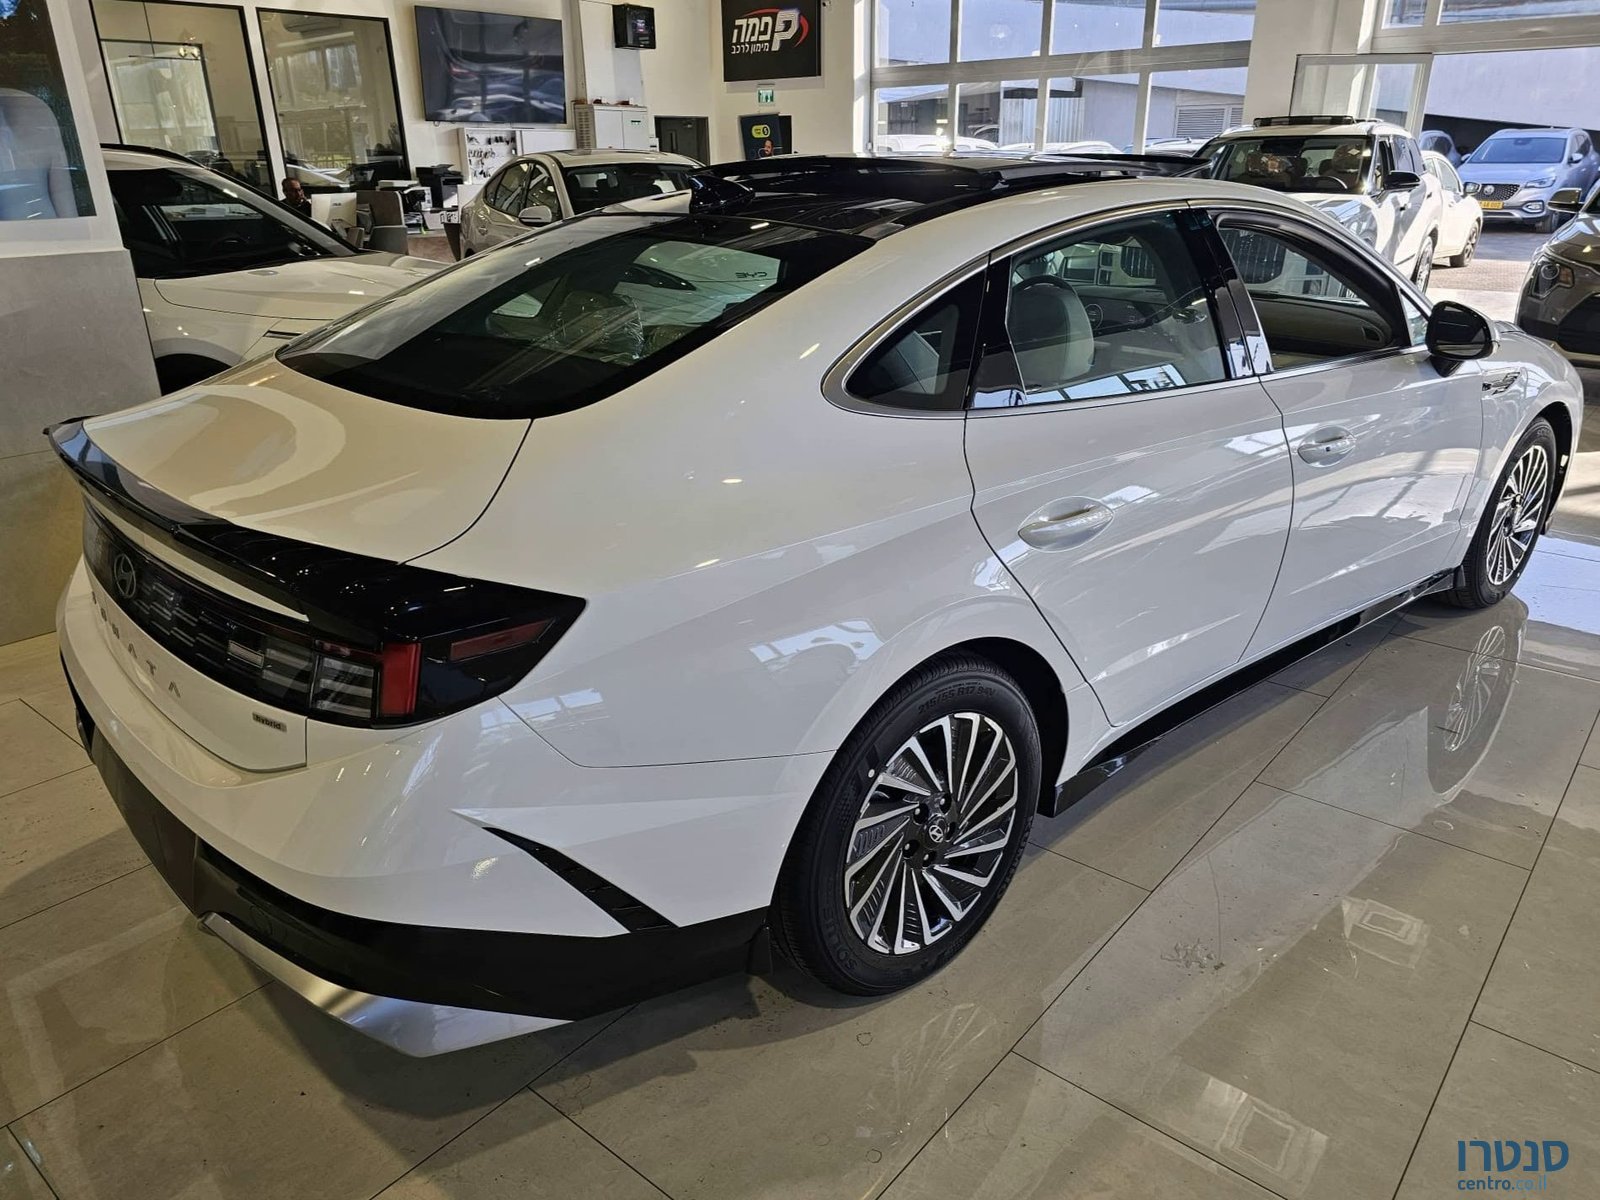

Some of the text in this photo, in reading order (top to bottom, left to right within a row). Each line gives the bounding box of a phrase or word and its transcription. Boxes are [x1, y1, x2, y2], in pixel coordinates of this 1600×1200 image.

[732, 16, 773, 43] פמה
[731, 43, 769, 54] מימון לרכב
[918, 689, 955, 713] 215/55
[957, 685, 975, 697] R17
